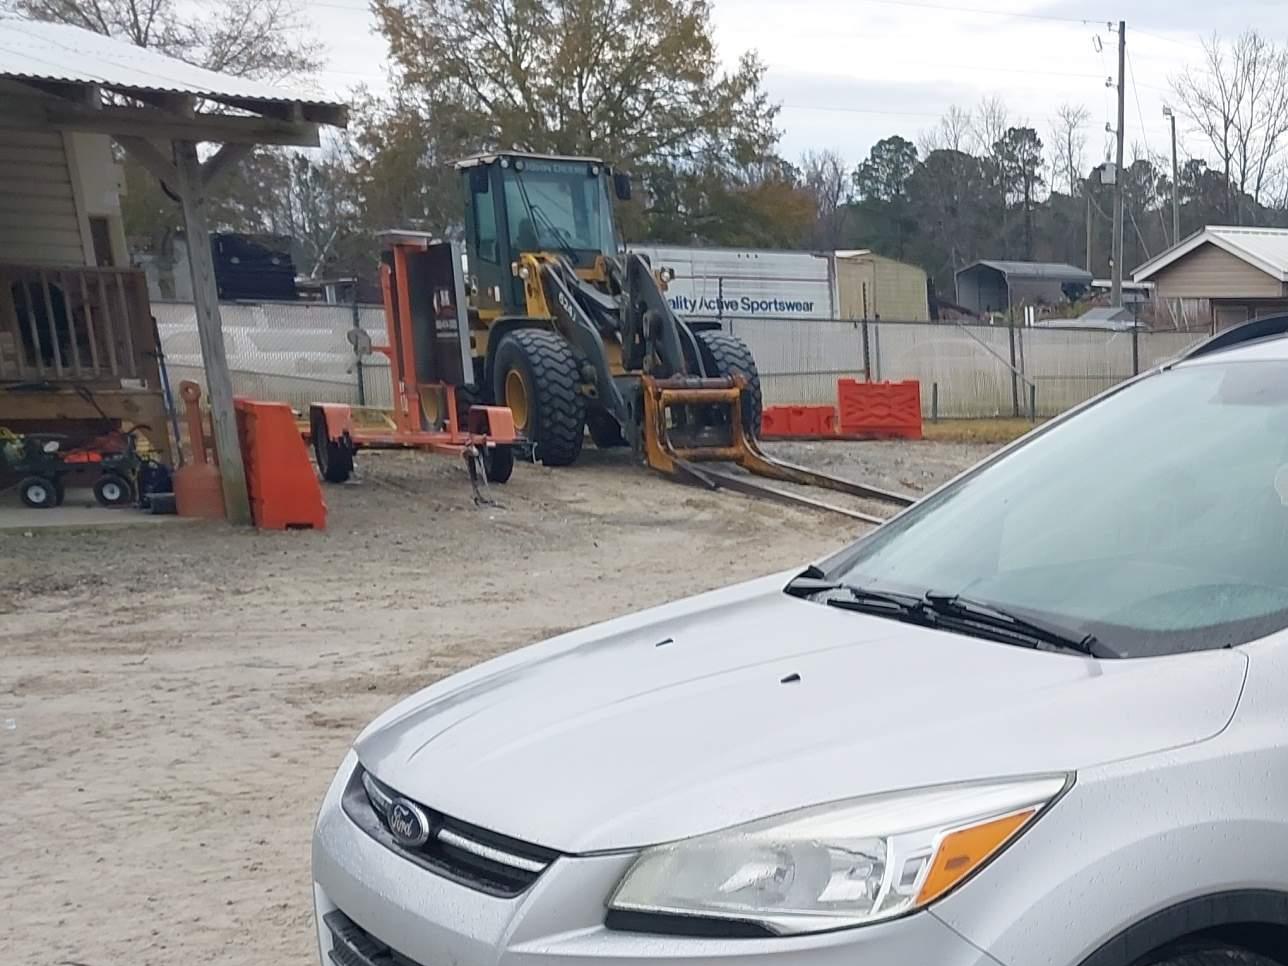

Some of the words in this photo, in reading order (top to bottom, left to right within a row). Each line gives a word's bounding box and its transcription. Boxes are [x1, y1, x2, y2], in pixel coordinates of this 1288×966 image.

[668, 296, 697, 312] ality
[700, 296, 738, 311] Active
[741, 297, 814, 314] Sportswear
[391, 804, 414, 837] Ford
